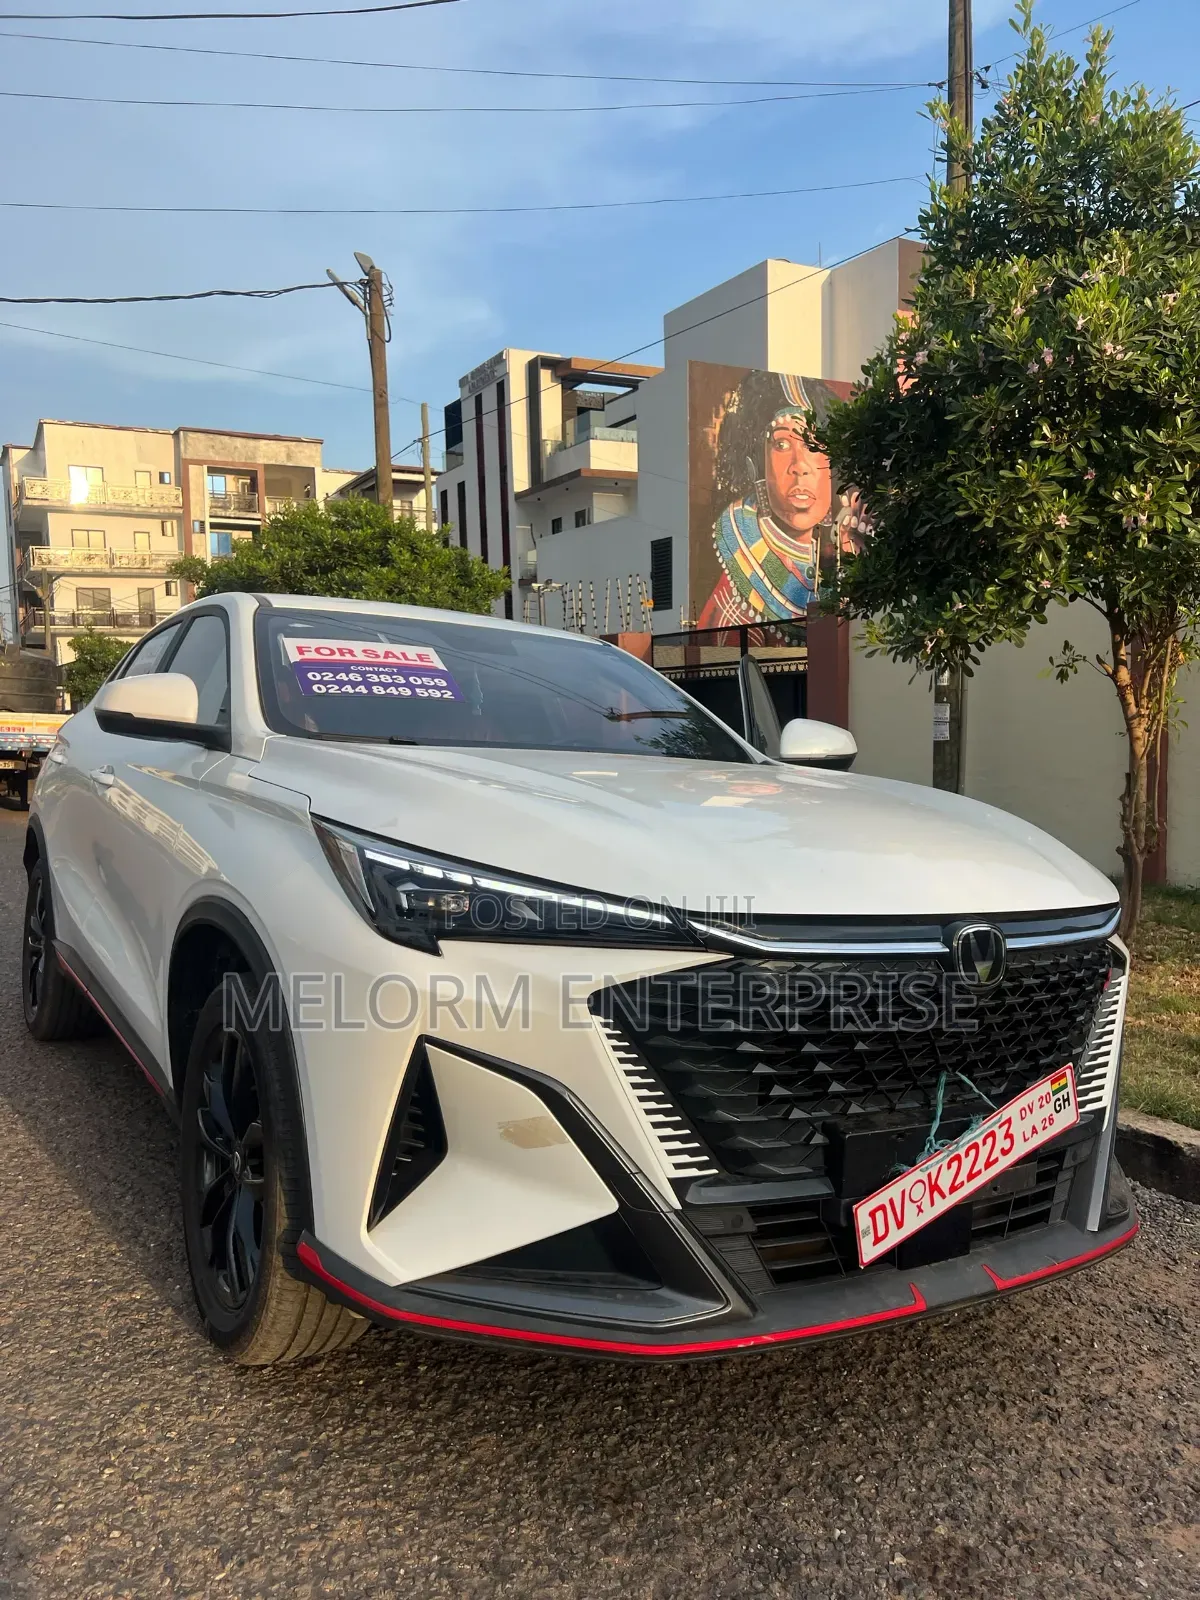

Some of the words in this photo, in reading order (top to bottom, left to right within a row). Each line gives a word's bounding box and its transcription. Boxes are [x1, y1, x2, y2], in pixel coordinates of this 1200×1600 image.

[296, 645, 358, 658] FOR
[361, 649, 433, 663] SALE
[307, 671, 364, 682] 0246
[366, 673, 406, 684] 383
[410, 676, 448, 687] 059
[350, 665, 399, 673] CONTACT
[312, 684, 368, 694] 0244
[372, 685, 412, 696] 849
[415, 687, 455, 699] 592
[1019, 1100, 1035, 1121] DV
[1038, 1091, 1051, 1110] 20
[1053, 1092, 1071, 1114] GH
[1022, 1126, 1038, 1143] LA
[1041, 1113, 1055, 1132] 26
[868, 1188, 906, 1247] DV
[927, 1116, 1015, 1207] K2223
